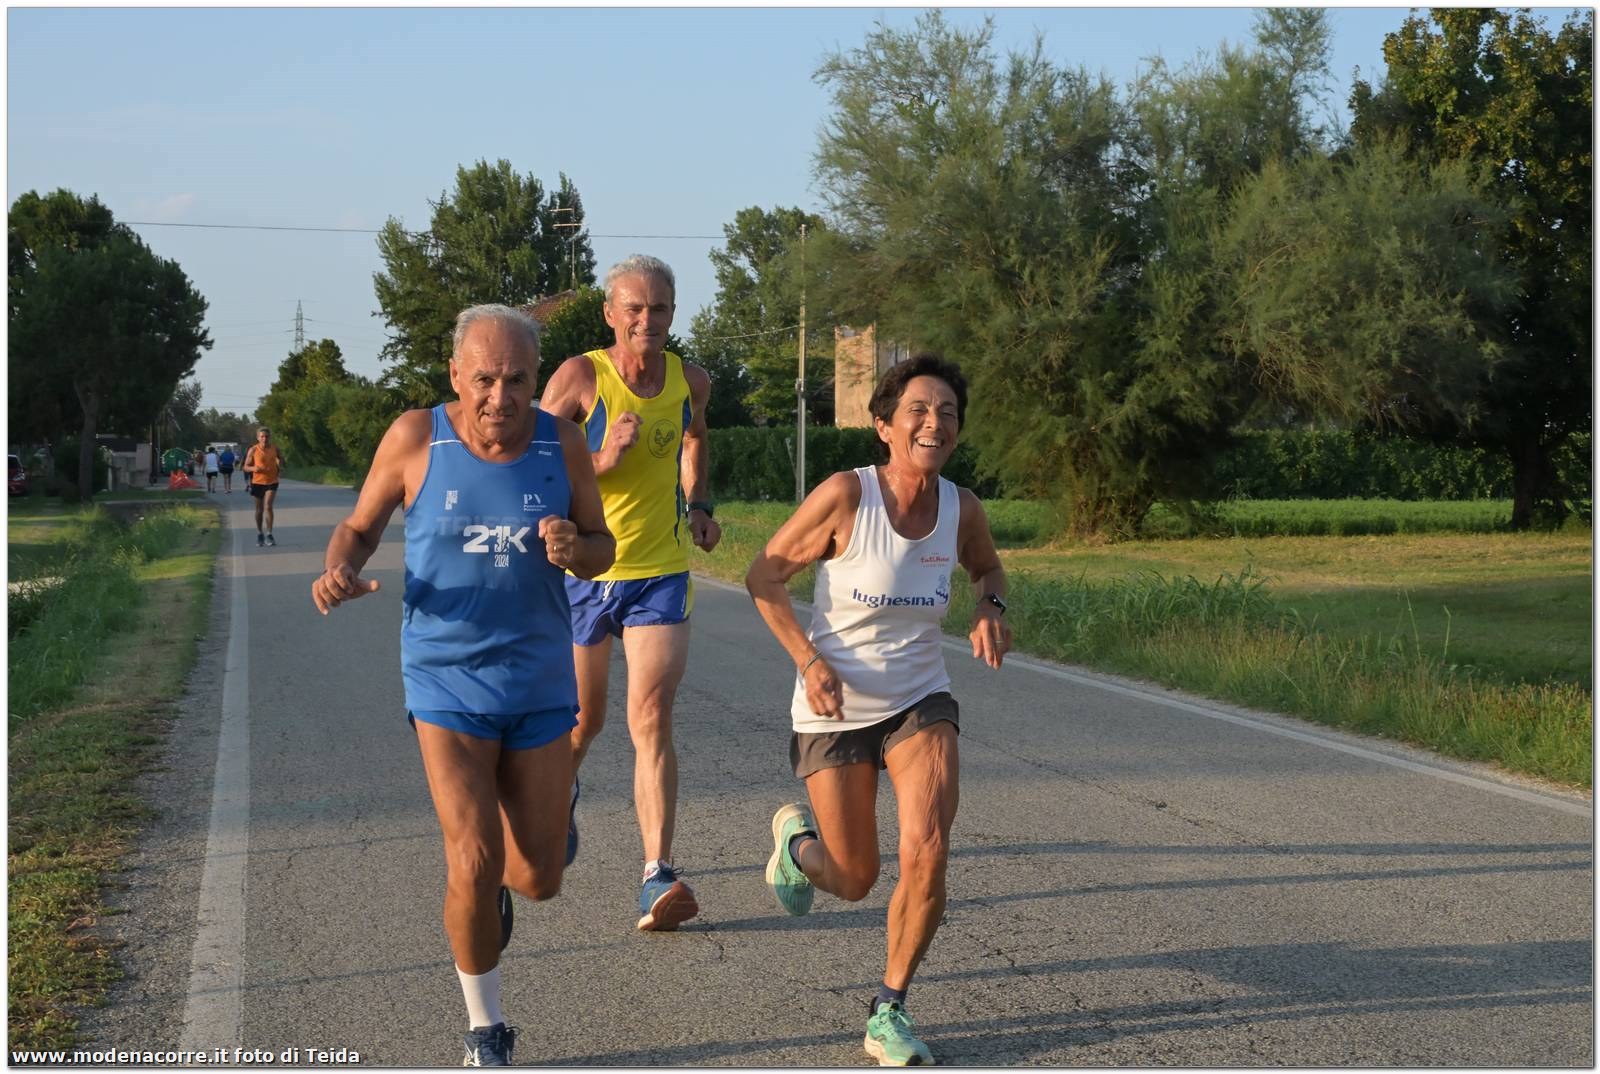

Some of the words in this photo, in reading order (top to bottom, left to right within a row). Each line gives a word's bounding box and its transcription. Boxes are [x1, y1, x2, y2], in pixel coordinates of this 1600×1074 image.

[463, 525, 530, 553] 21K
[494, 554, 509, 567] 2024
[852, 588, 935, 608] lughesina
